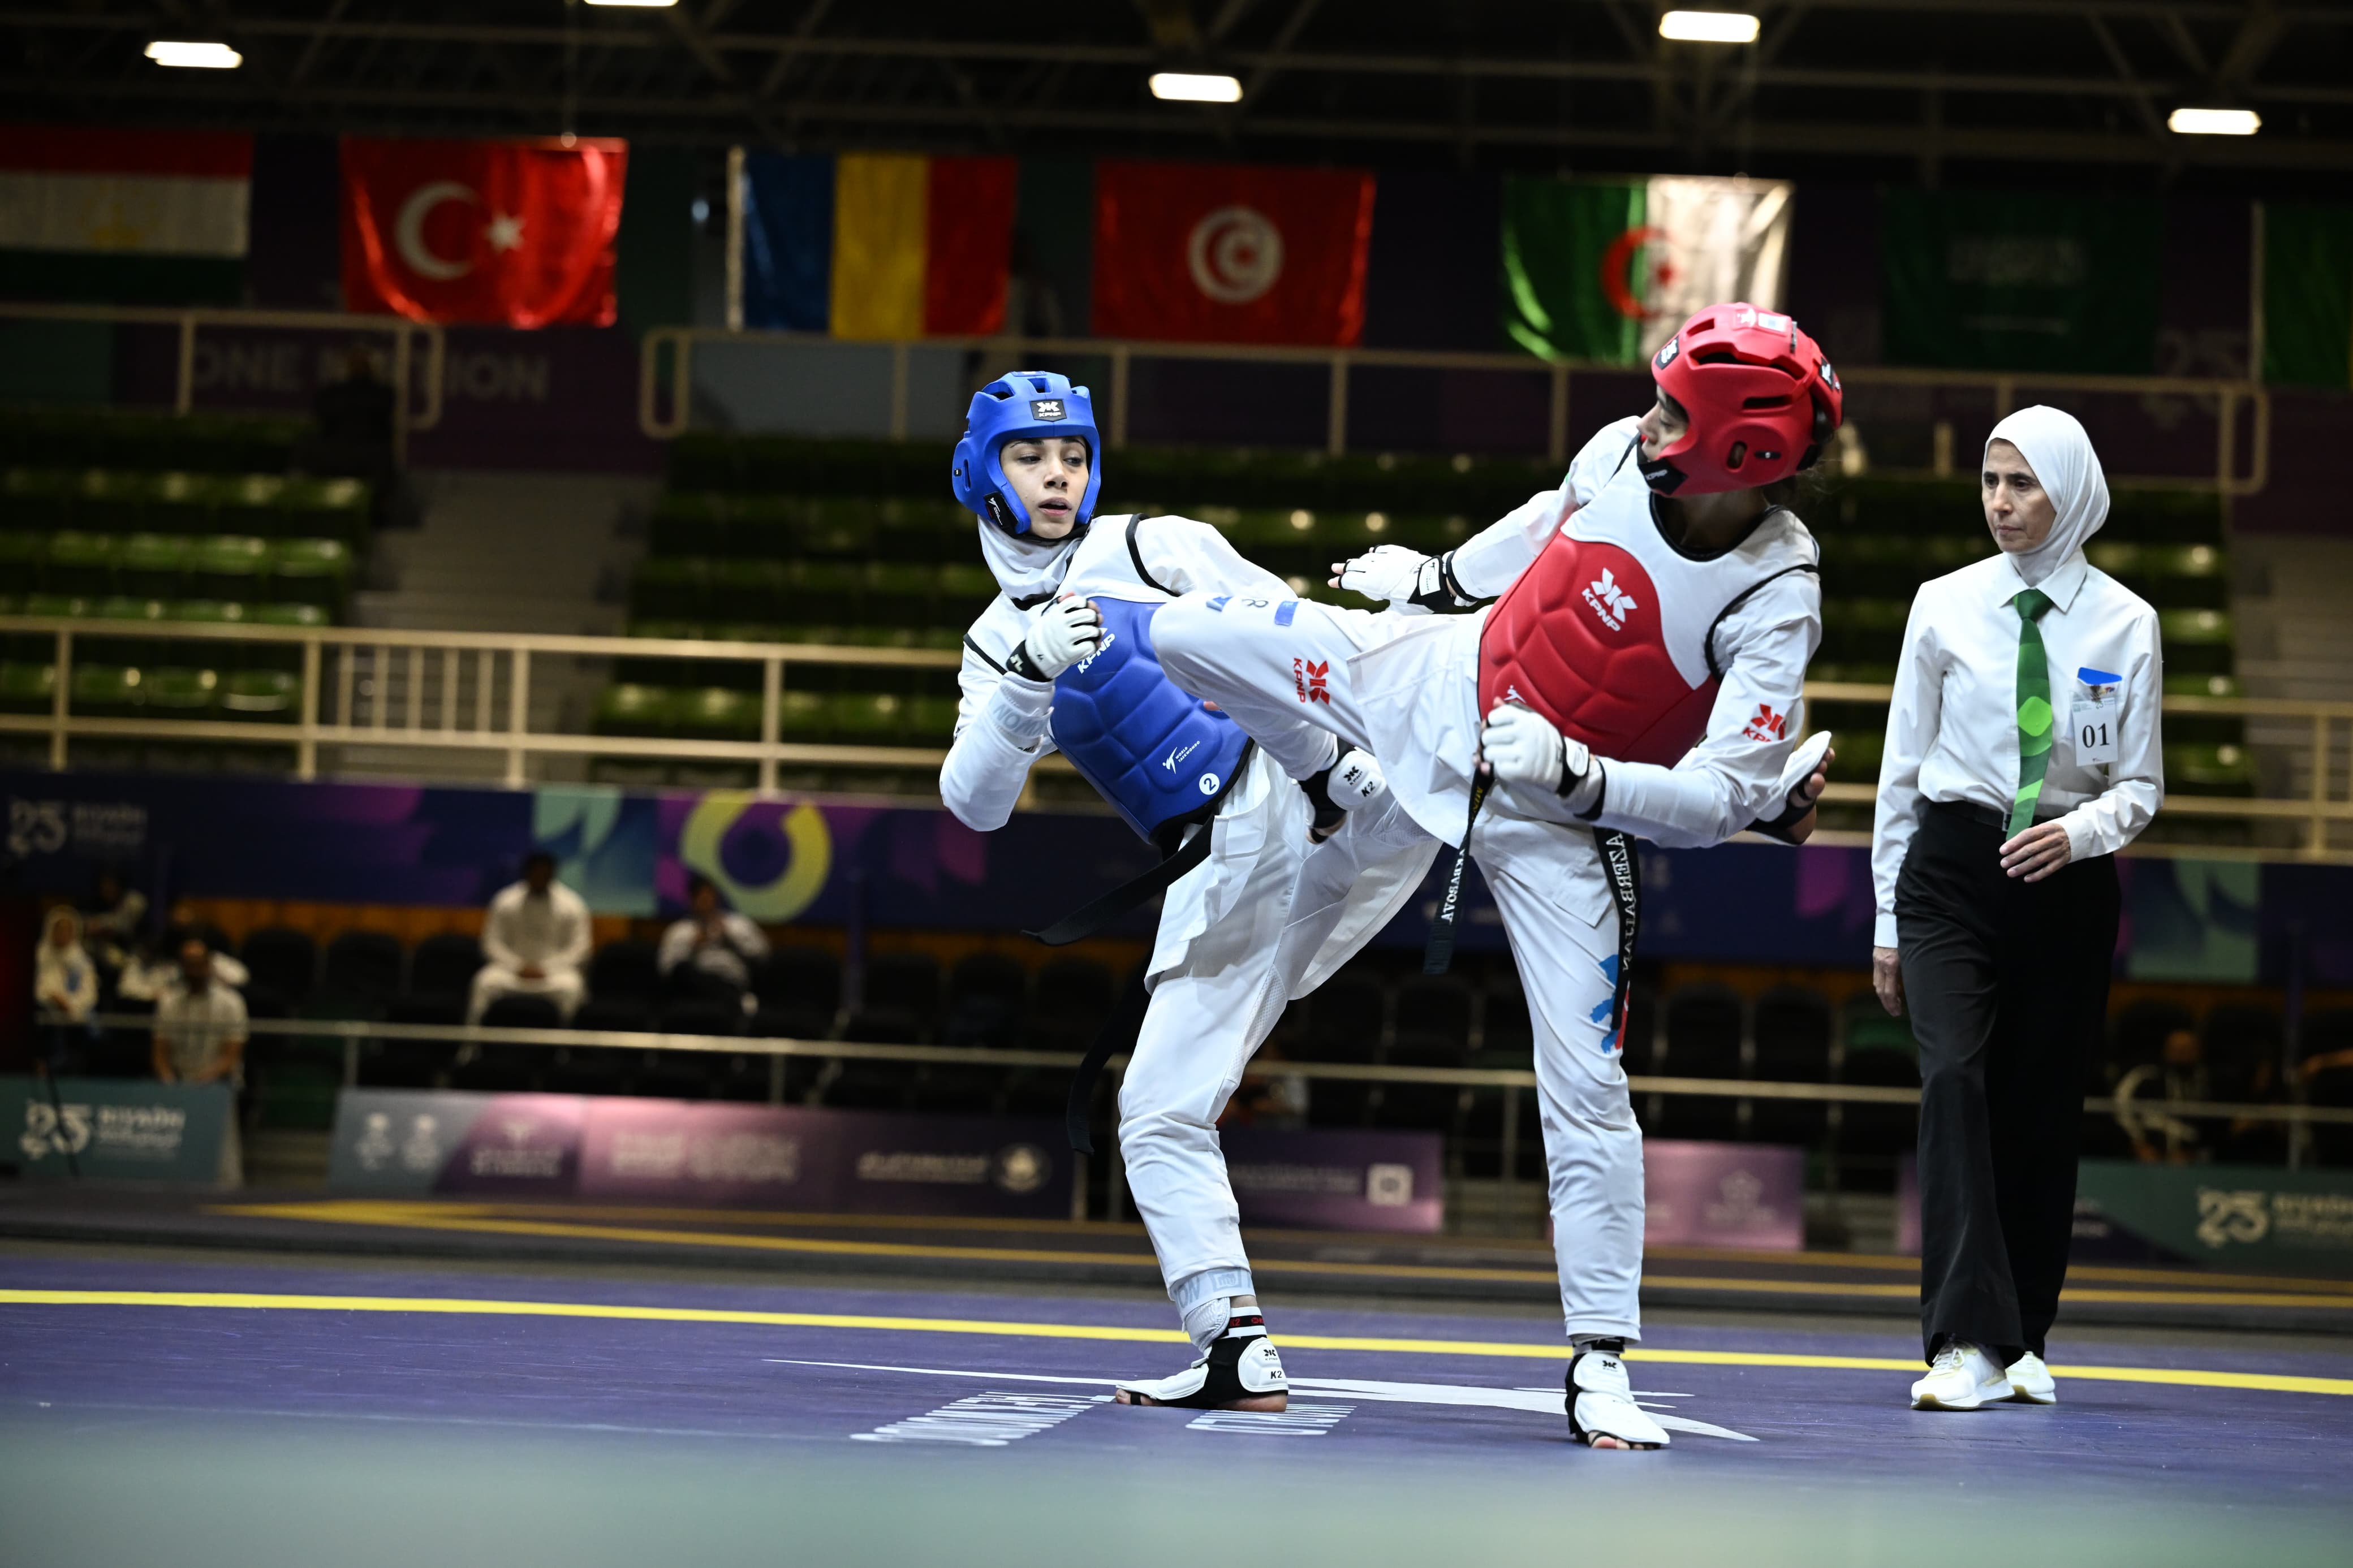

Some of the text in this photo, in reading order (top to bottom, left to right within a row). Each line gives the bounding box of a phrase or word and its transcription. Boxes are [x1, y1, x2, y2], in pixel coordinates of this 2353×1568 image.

[1581, 588, 1621, 632] KPNP
[1077, 633, 1115, 674] KPNP
[1293, 657, 1306, 703] KPNP
[2082, 723, 2110, 749] 01
[1175, 746, 1188, 759] WORLD
[1178, 740, 1200, 762] TAEKWONDO
[1204, 777, 1216, 792] 2
[1361, 781, 1376, 797] K2
[1270, 1371, 1282, 1379] K2
